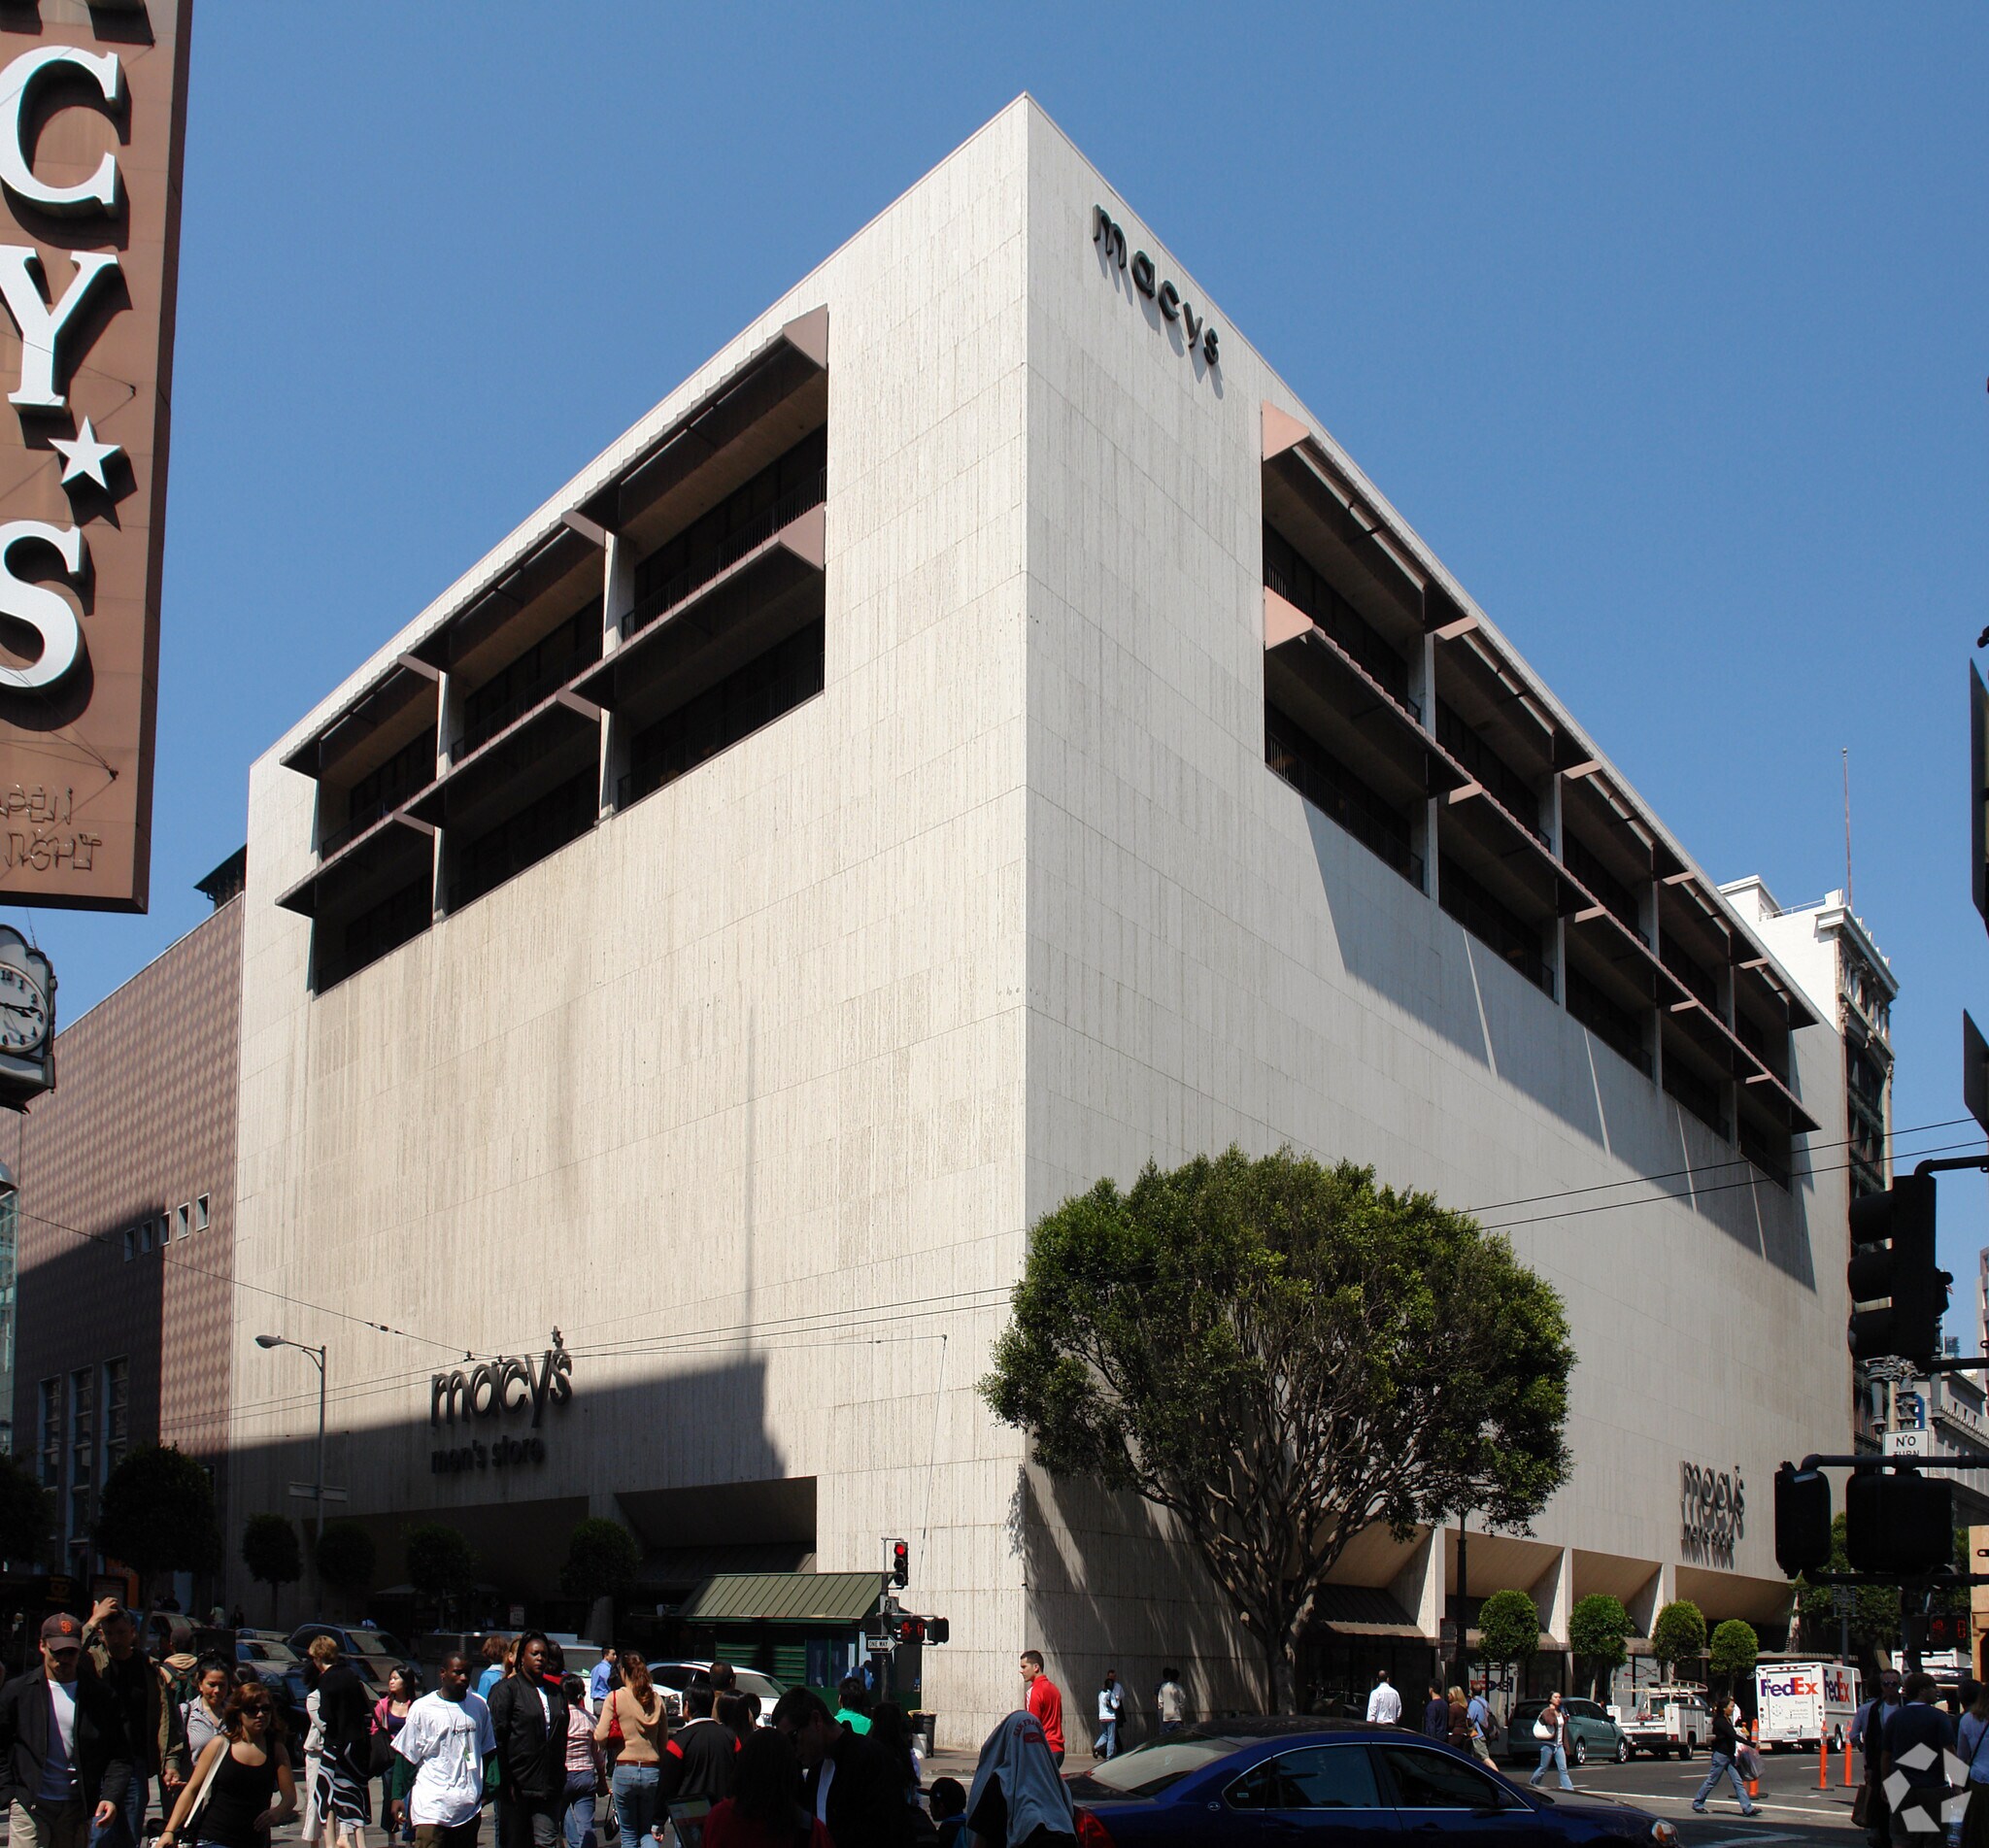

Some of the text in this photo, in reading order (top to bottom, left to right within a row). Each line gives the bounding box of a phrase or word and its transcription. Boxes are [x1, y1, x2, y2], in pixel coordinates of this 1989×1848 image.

[491, 1434, 546, 1468] store
[1896, 1435, 1916, 1447] NO
[1760, 1676, 1818, 1697] FedEx
[1824, 1668, 1850, 1703] FedEx
